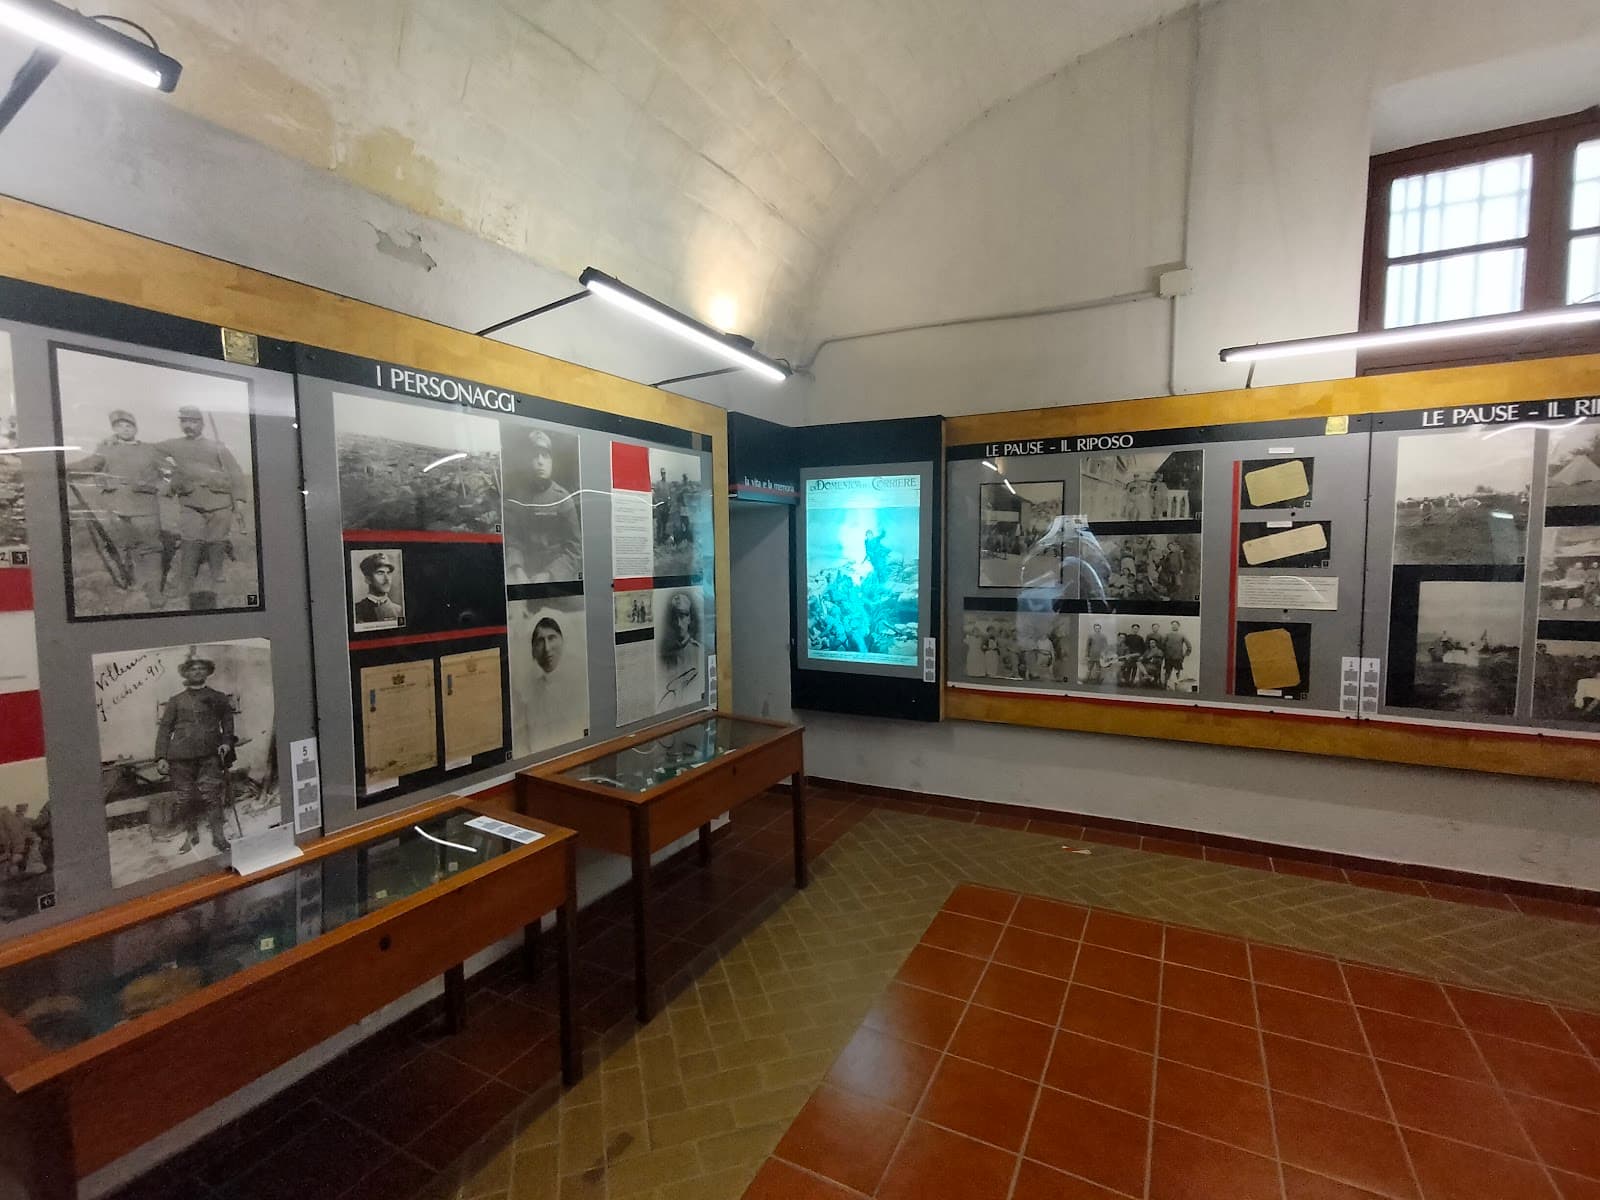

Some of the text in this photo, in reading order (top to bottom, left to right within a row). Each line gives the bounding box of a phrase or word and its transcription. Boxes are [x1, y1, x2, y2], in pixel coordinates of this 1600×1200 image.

[376, 365, 516, 413] I PERSONAGGI
[1422, 410, 1445, 427] LE
[1452, 404, 1520, 425] PAUSE
[1547, 401, 1565, 418] IL
[1575, 398, 1600, 416] RI
[986, 444, 1000, 457] LE
[1004, 441, 1044, 455] PAUSE
[1061, 439, 1071, 452] IL
[1077, 434, 1134, 451] RIPOSO
[302, 746, 308, 756] 5
